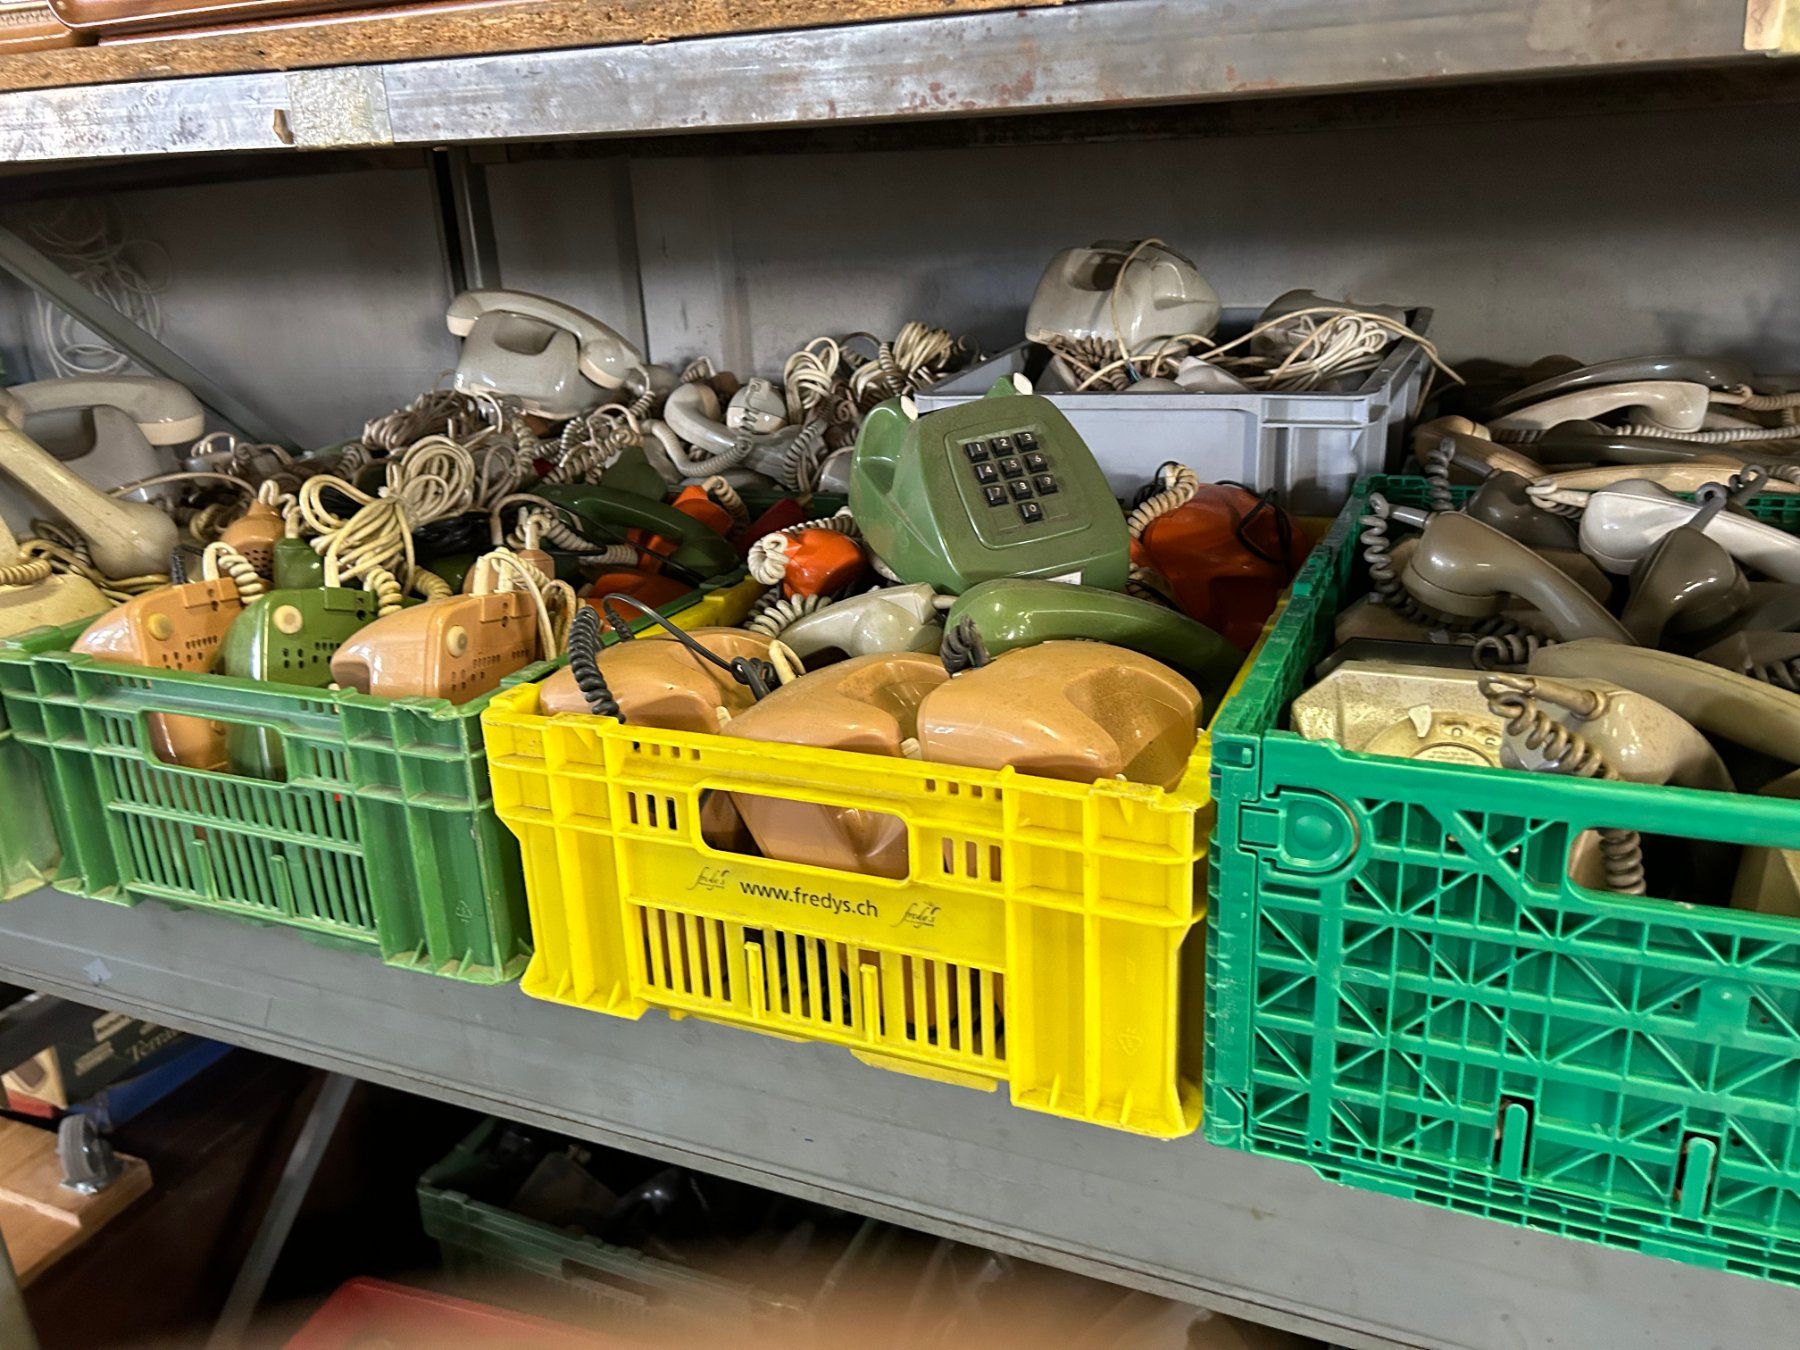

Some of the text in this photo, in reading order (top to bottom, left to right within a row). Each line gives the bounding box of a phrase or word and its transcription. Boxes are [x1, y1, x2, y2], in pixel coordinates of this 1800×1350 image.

[1000, 438, 1008, 447] 2
[1024, 433, 1032, 441] 3
[985, 455, 1042, 473] 4 5 6
[993, 487, 1001, 496] 7
[1044, 476, 1052, 485] 9
[1029, 504, 1037, 513] 0
[739, 881, 878, 917] www.fredys.ch
